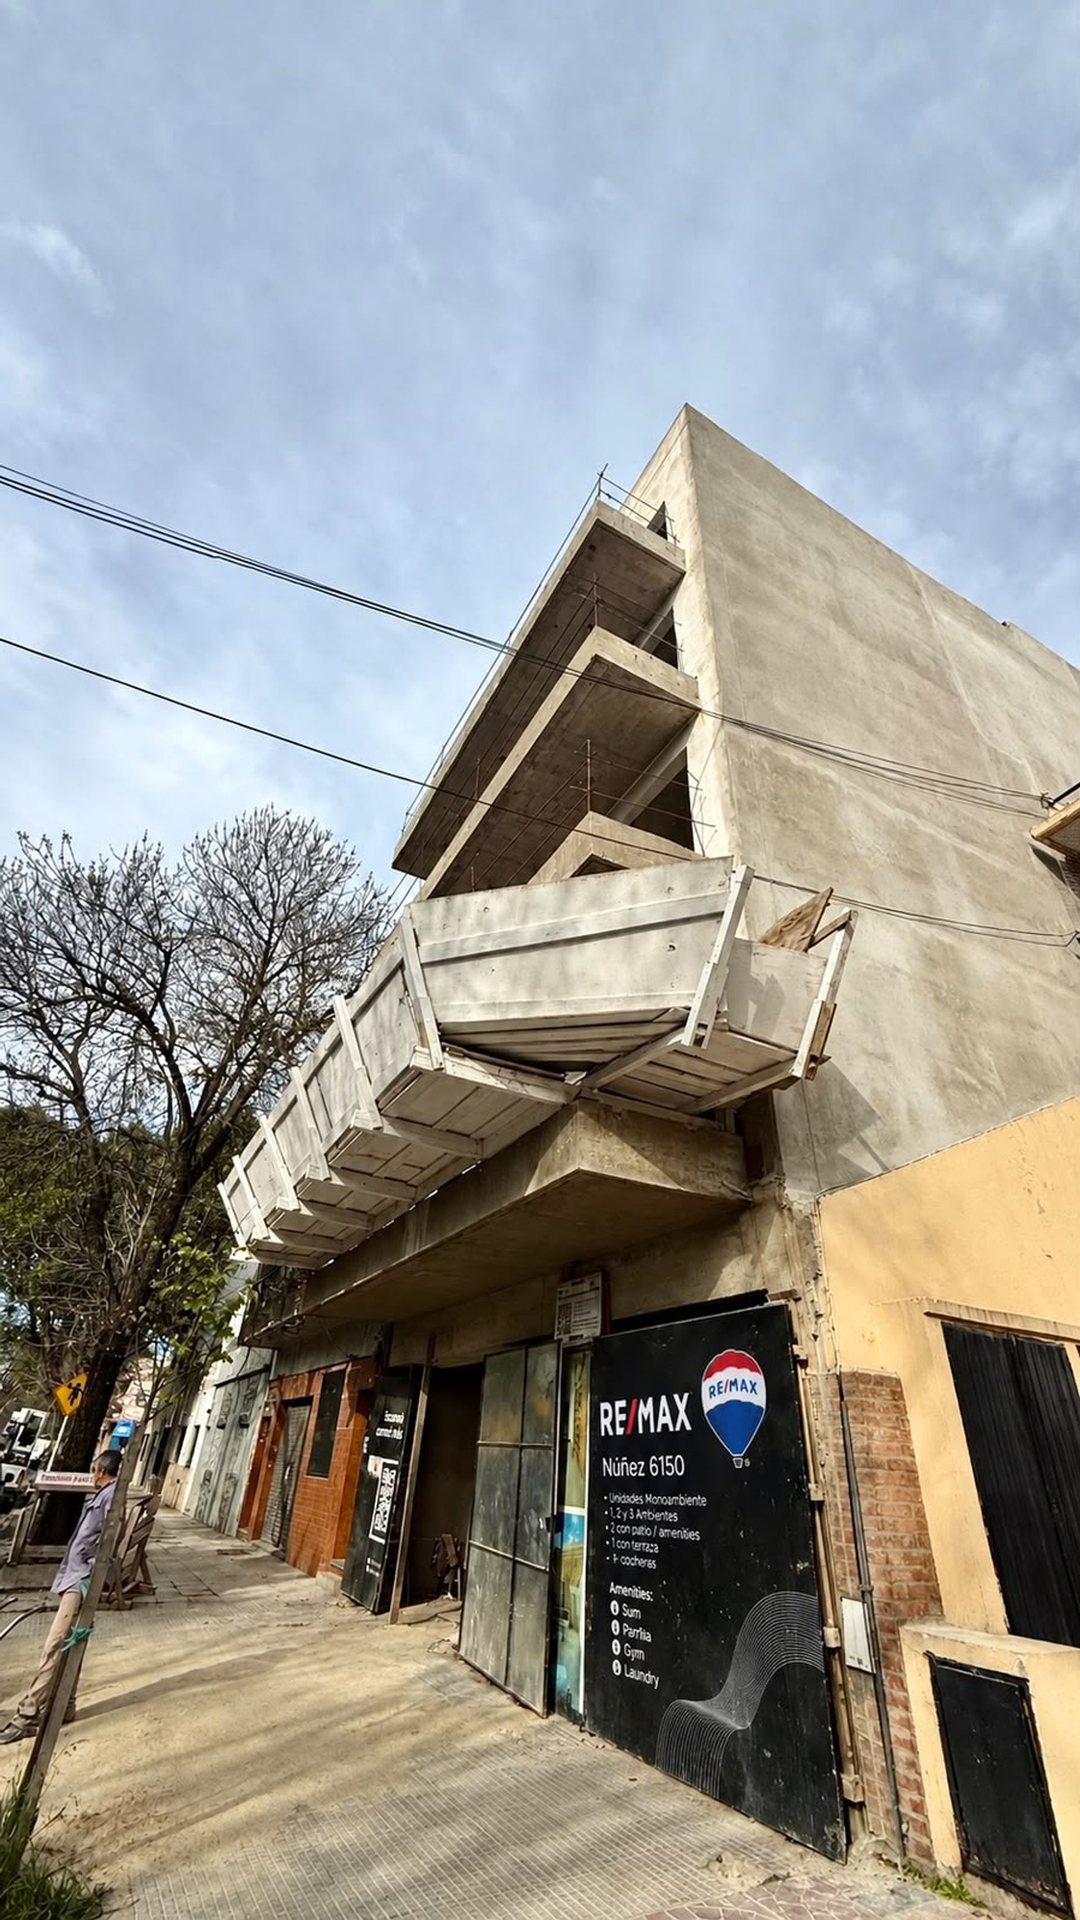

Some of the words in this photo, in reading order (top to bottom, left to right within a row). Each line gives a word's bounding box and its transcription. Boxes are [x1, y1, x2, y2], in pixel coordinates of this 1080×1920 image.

[708, 1378, 759, 1399] RE/MAX
[600, 1393, 692, 1437] RE/MAX
[602, 1456, 646, 1477] Núñez
[649, 1454, 685, 1477] 6150
[609, 1492, 644, 1505] Unidades
[645, 1493, 707, 1507] Monoambiente
[622, 1510, 628, 1521] y
[629, 1508, 635, 1520] 3
[635, 1508, 679, 1522] Ambientes
[610, 1521, 616, 1534] 2
[616, 1524, 631, 1534] con
[659, 1527, 700, 1541] amenities
[616, 1539, 631, 1550] con
[620, 1554, 657, 1569] cocheras
[609, 1581, 654, 1602] Amenities:
[621, 1602, 642, 1620] Sum
[623, 1643, 645, 1662] Gym
[624, 1663, 660, 1690] Laundry
